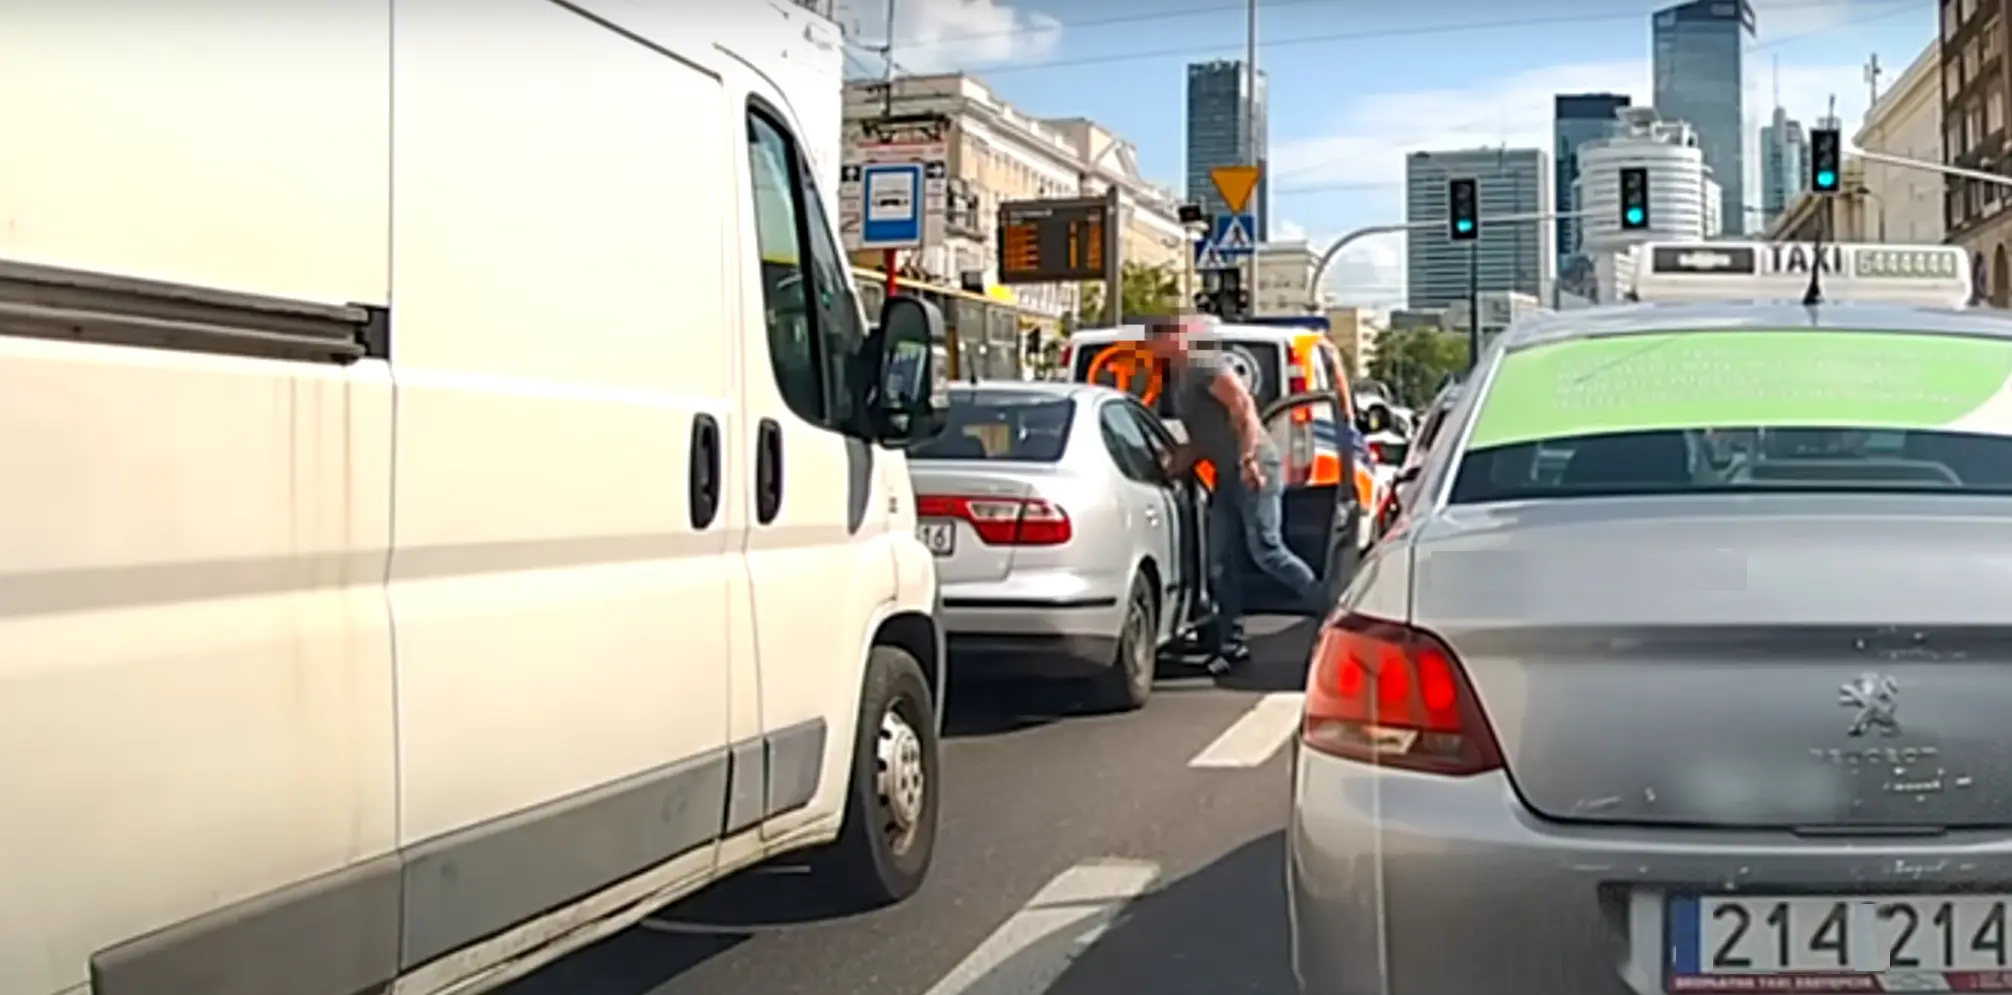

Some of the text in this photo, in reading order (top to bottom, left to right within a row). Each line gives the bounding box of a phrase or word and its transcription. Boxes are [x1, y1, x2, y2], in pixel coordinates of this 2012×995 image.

[1772, 246, 1841, 273] TAXI
[1711, 901, 2008, 967] 214 214
